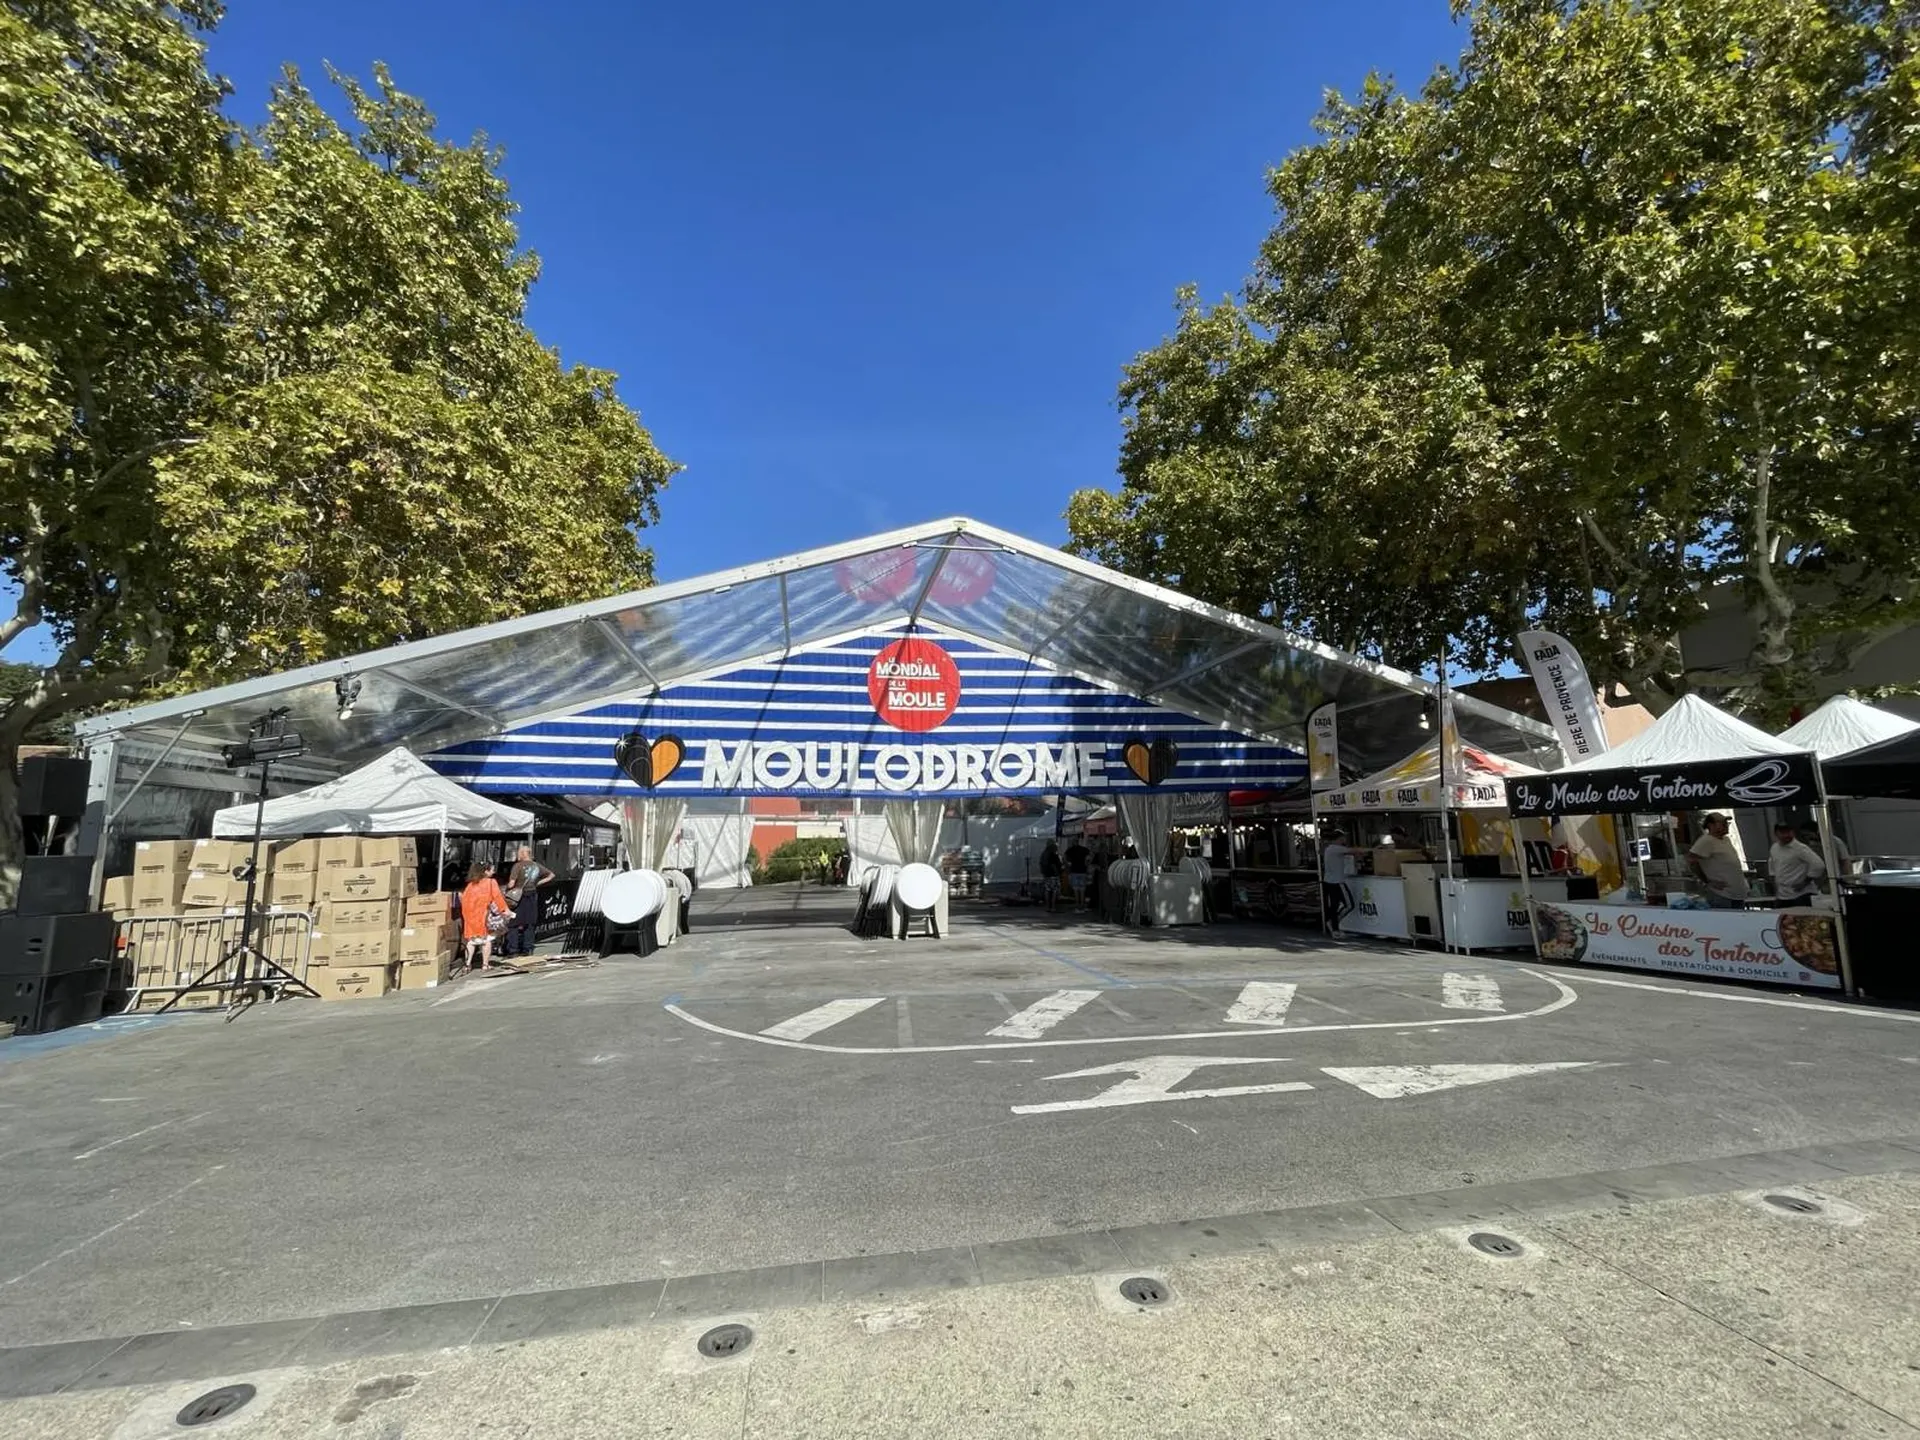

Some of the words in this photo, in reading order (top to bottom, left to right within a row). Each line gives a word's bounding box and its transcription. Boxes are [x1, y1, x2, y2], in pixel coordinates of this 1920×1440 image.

[1533, 644, 1561, 661] FADA
[1547, 664, 1574, 711] PROVENCE
[888, 691, 946, 707] MOULE
[1314, 717, 1332, 726] FADA
[1564, 712, 1579, 726] DE
[701, 739, 1109, 791] MOULODROME
[1329, 793, 1346, 806] FADA
[1361, 789, 1381, 804] FADA
[1397, 788, 1419, 803] FADA
[1471, 786, 1497, 801] FADA
[1516, 785, 1540, 810] La
[1545, 782, 1602, 810] Moule
[1607, 784, 1640, 801] des
[1639, 774, 1718, 803] Tontons
[1359, 902, 1378, 916] FADA
[1585, 912, 1612, 936] La
[1617, 914, 1694, 939] Cuisine
[1658, 941, 1694, 956] des
[1695, 937, 1784, 965] Tontons
[1661, 960, 1725, 973] PRESTATIONS
[1738, 966, 1790, 978] DOMICILE
